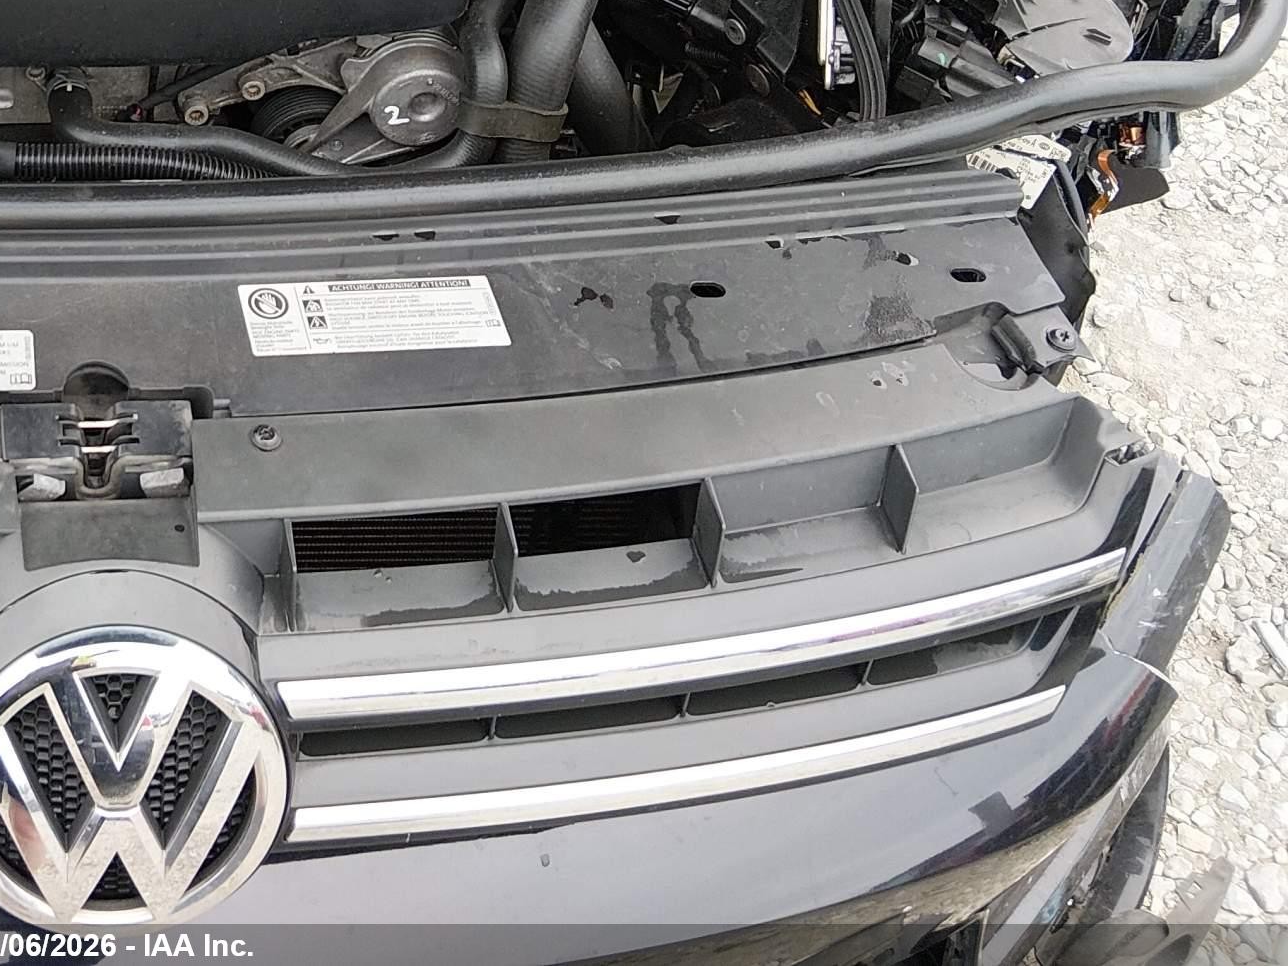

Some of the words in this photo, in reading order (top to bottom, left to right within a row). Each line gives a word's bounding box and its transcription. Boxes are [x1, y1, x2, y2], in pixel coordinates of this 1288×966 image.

[384, 105, 410, 125] 2
[332, 283, 374, 292] ACHTUNG!
[376, 281, 418, 290] WARNING!
[419, 279, 468, 288] ATTENTION!
